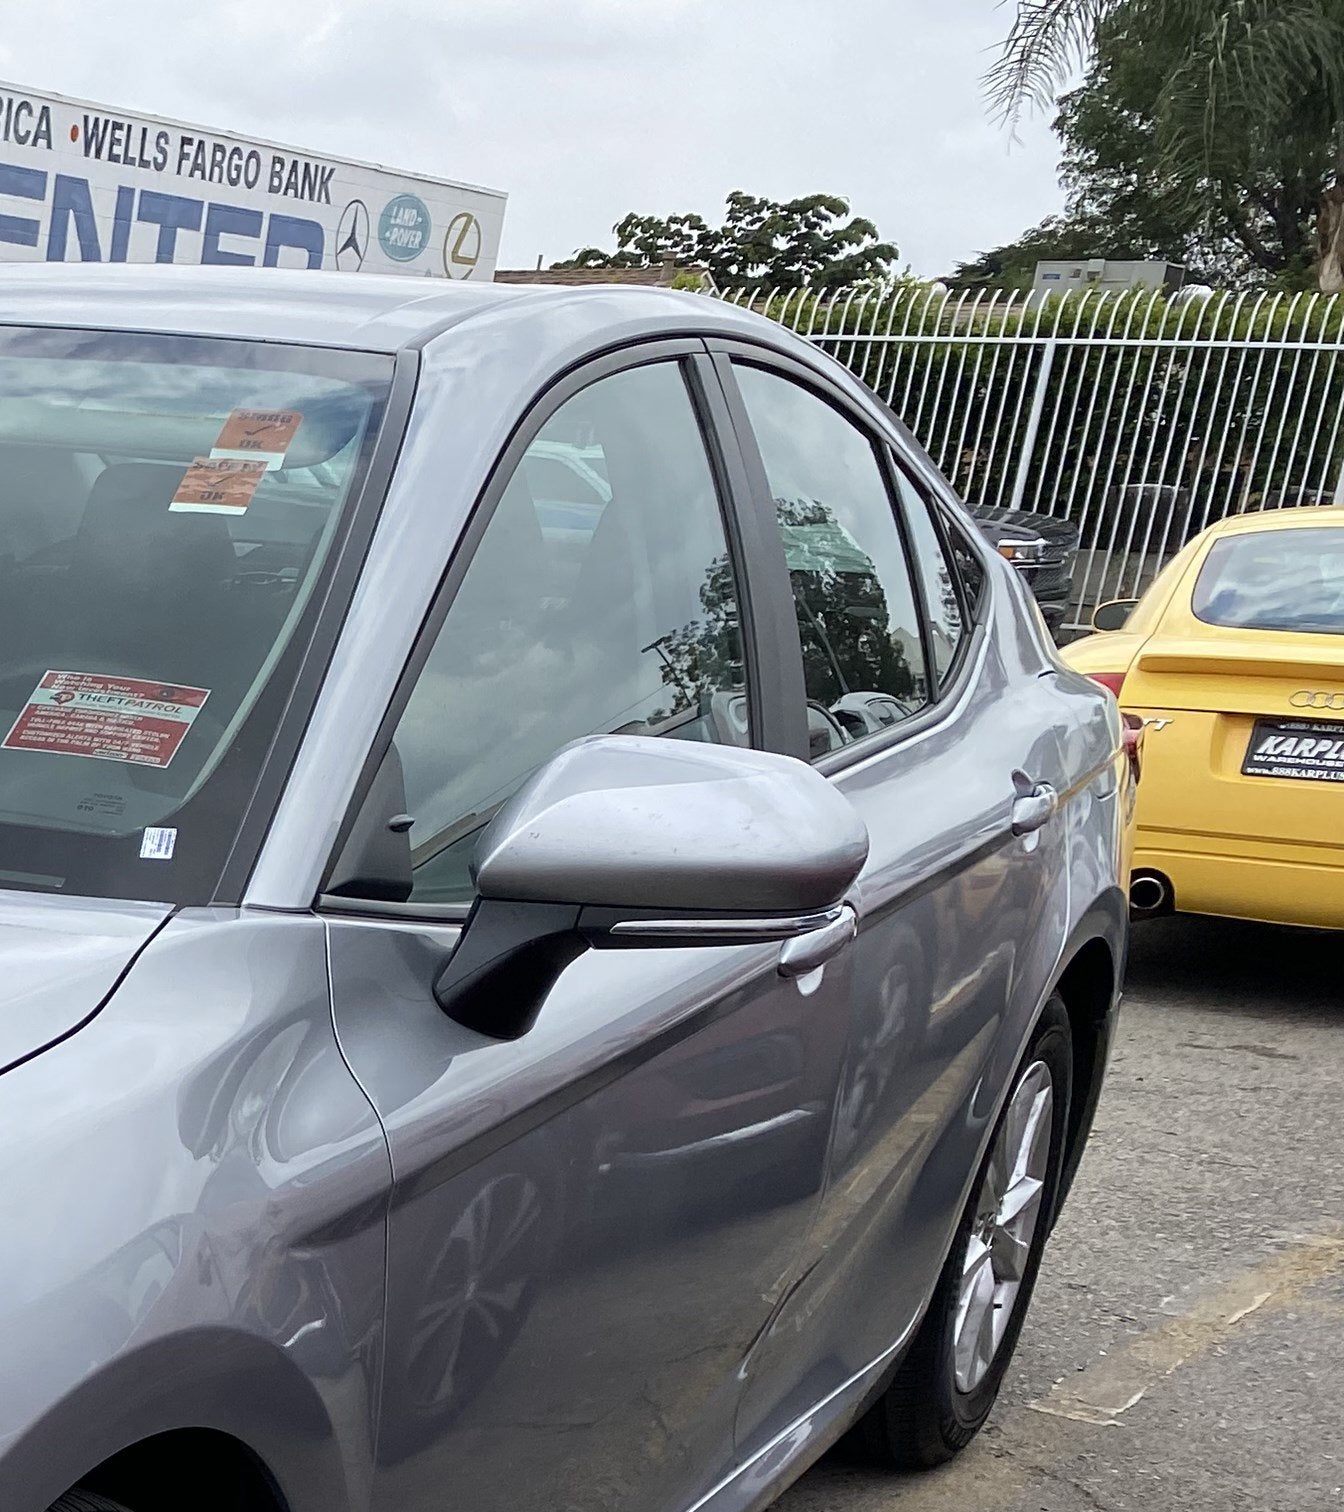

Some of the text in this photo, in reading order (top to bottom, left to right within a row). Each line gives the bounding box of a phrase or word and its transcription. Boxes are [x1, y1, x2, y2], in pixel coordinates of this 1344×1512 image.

[82, 114, 169, 172] WELLS
[176, 135, 262, 190] FARGO
[268, 155, 336, 204] BANK
[1253, 754, 1344, 768] WAREHOUSE
